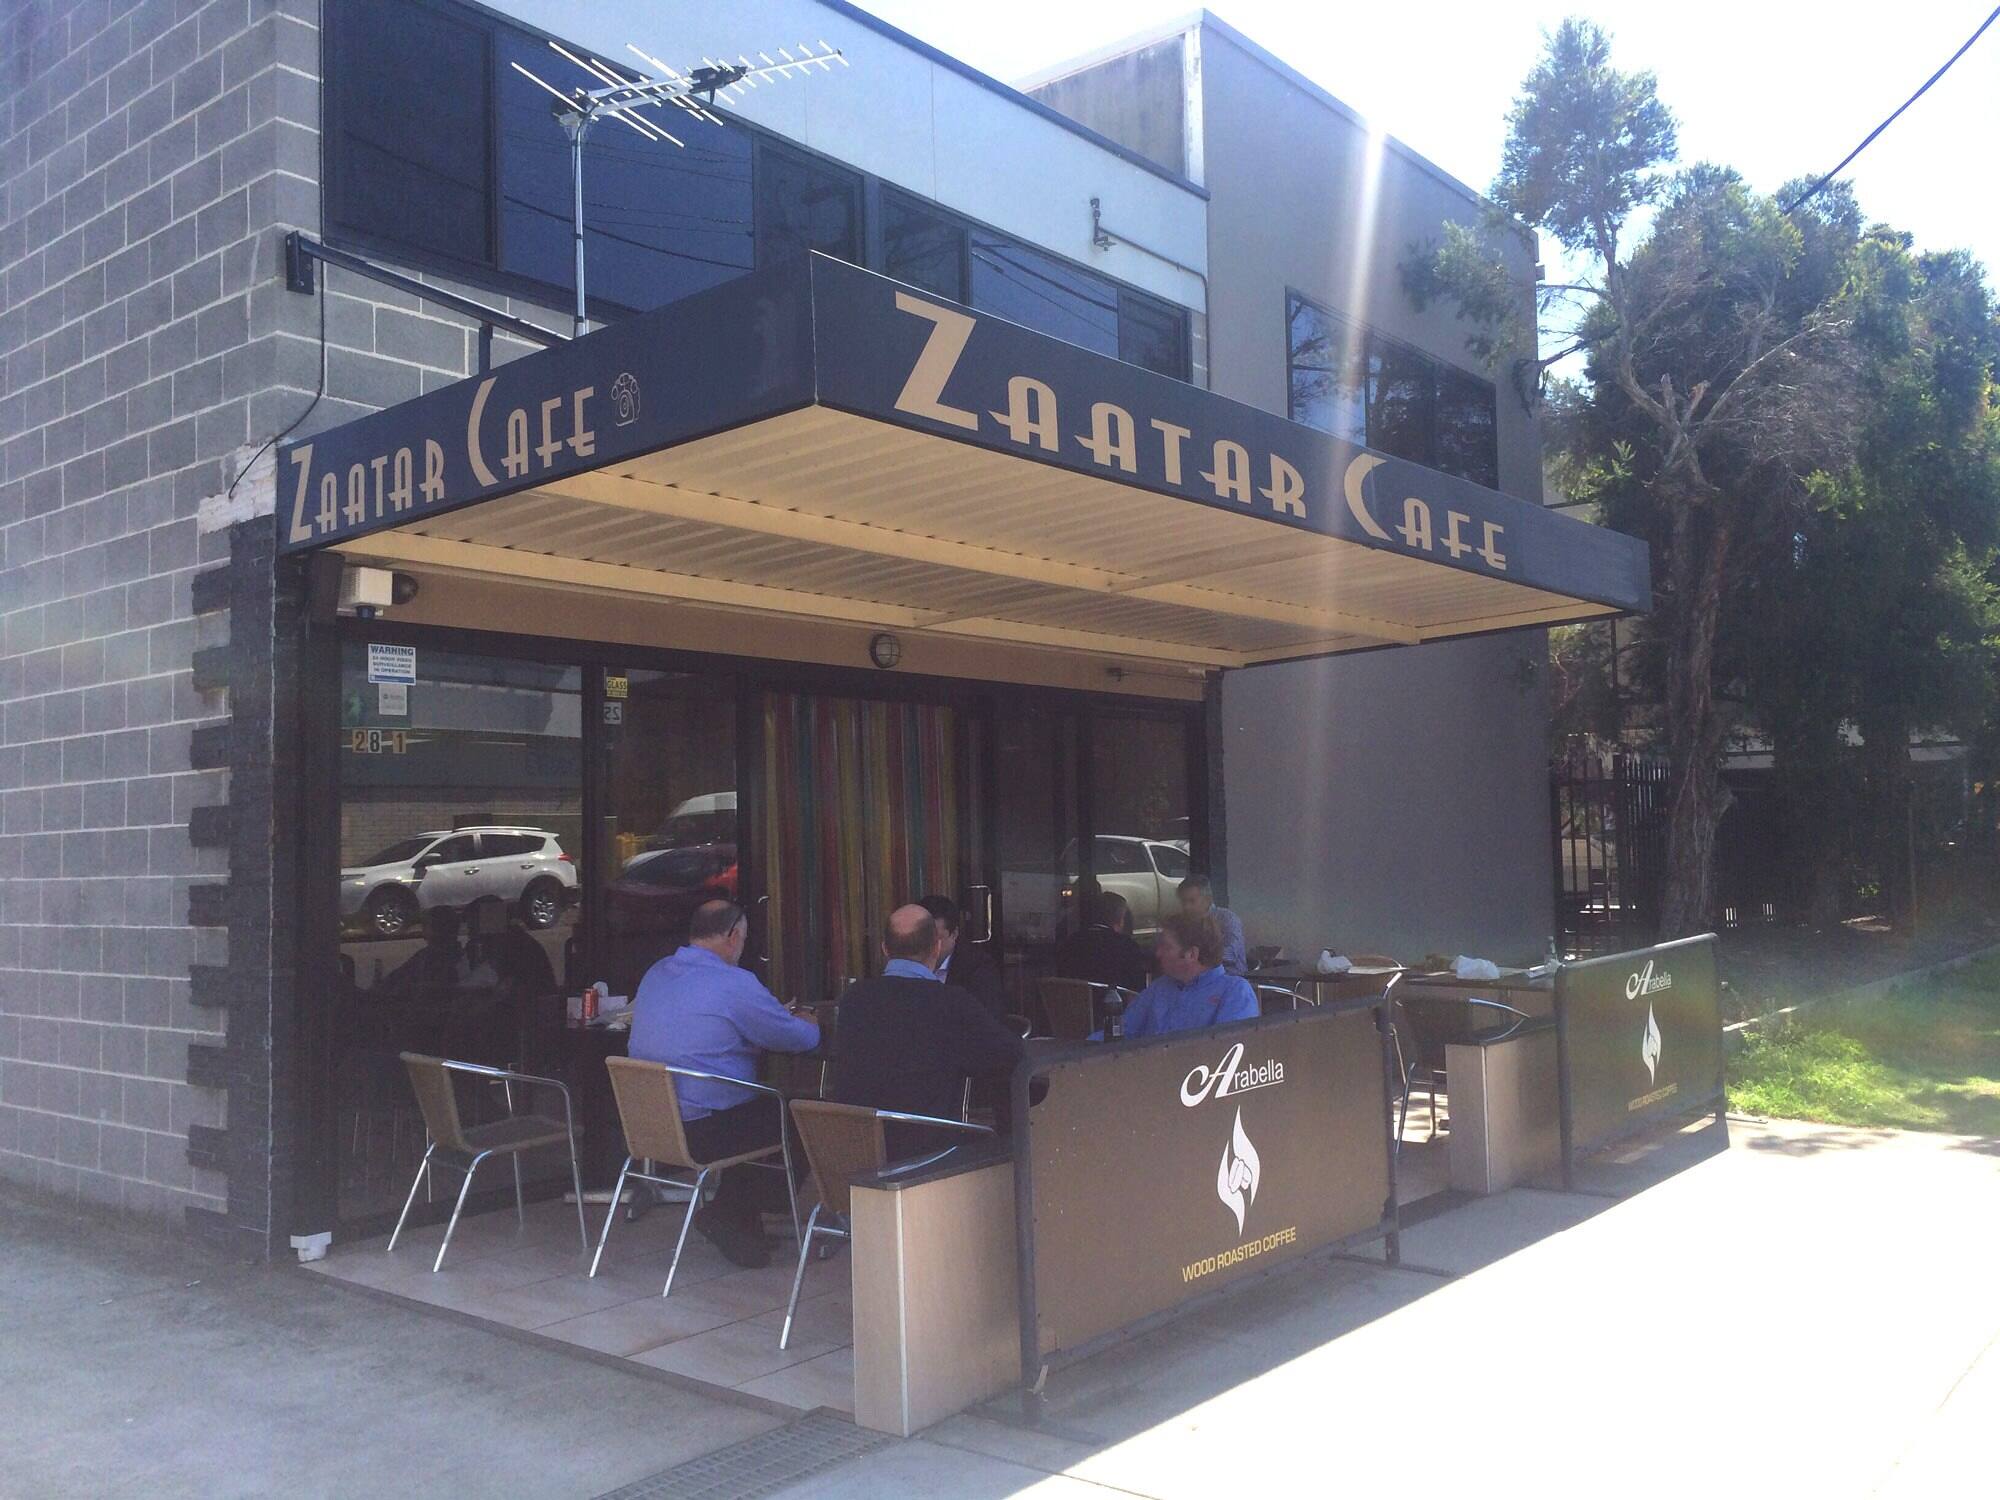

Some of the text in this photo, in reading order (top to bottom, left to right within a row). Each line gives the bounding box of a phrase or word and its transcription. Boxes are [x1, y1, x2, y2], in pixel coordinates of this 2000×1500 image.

[289, 376, 596, 544] ZAATAR CAFE
[894, 290, 1507, 570] ZAATAR CAFE
[370, 645, 414, 656] WARNING
[1626, 959, 1672, 1000] Arabella
[1180, 1042, 1285, 1108] Arabella
[1182, 1226, 1297, 1283] WOOD ROASTED COFFEE
